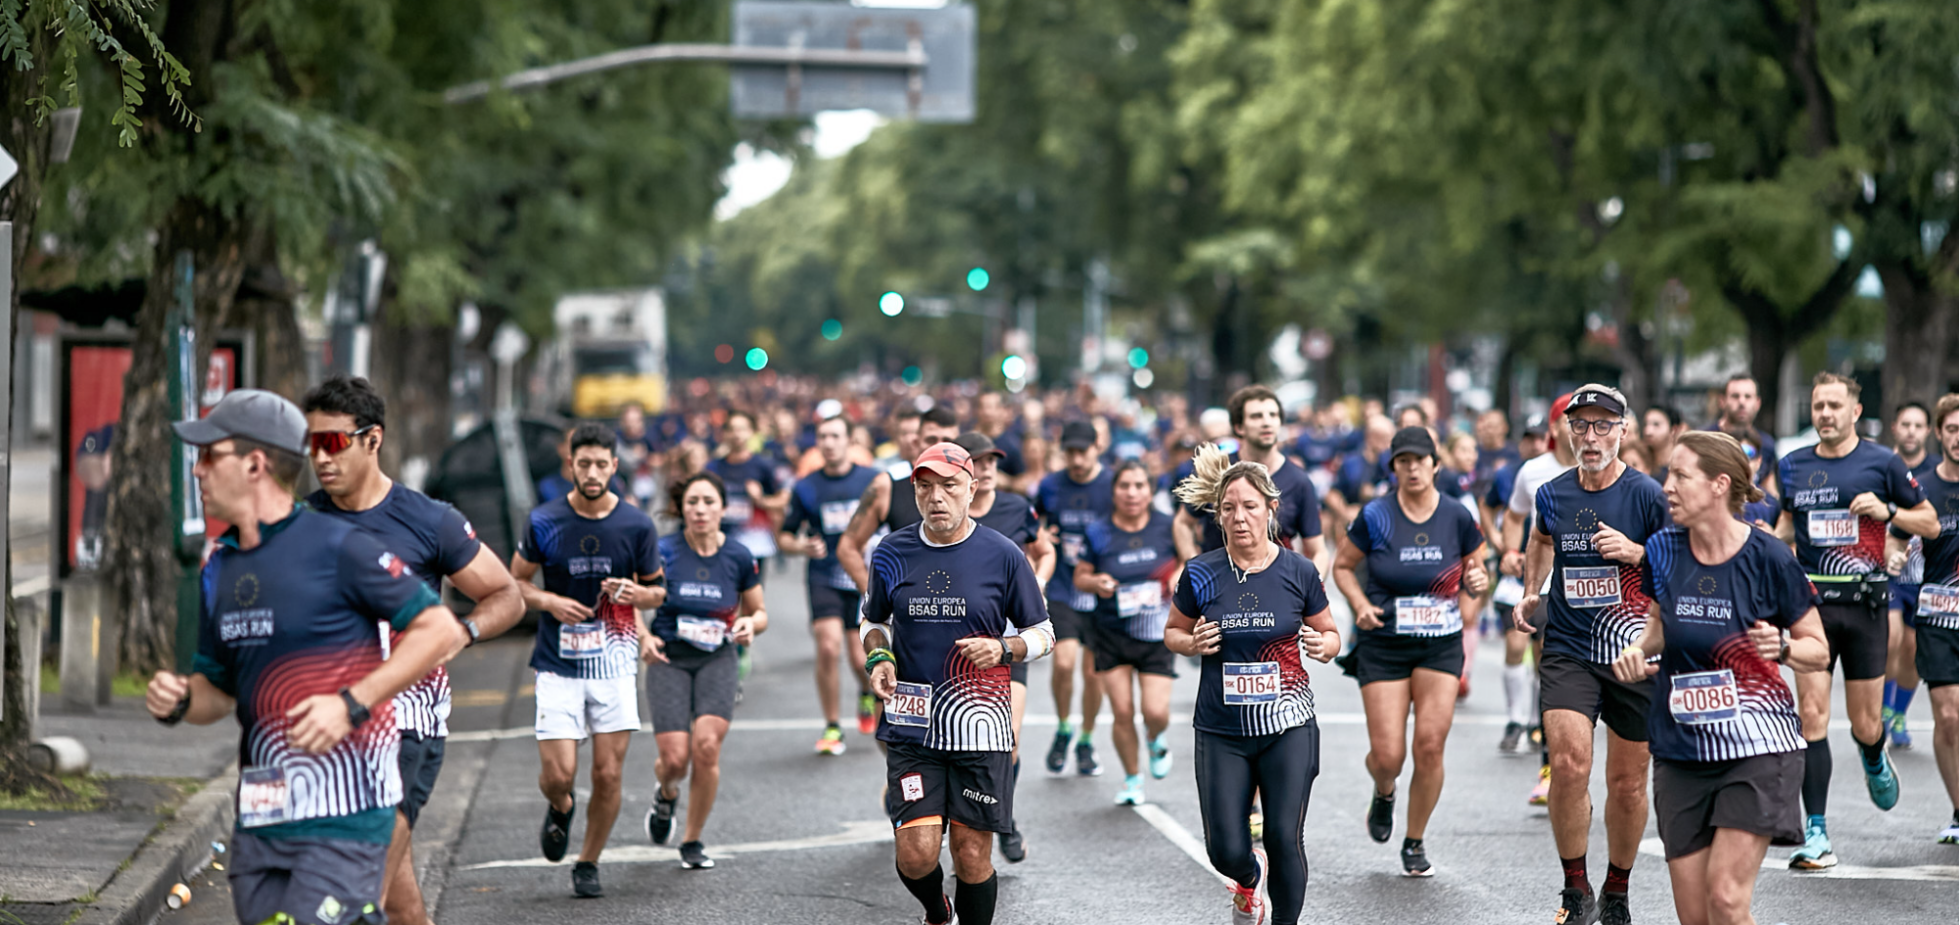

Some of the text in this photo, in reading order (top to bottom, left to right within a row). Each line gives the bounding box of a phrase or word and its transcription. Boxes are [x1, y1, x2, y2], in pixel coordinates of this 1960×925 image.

[1820, 491, 1838, 503] RUN
[1825, 519, 1853, 537] 1168
[1561, 541, 1587, 551] BSAS
[1576, 578, 1618, 597] 0050
[909, 597, 966, 605] UNION EUROPEA
[1678, 596, 1732, 607] UNION EUROPEA
[908, 605, 966, 616] BSAS RUN
[1413, 607, 1441, 624] 1182
[1676, 604, 1732, 620] BSAS RUN
[250, 619, 274, 637] RUN
[1221, 618, 1275, 629] BSAS RUN
[1237, 676, 1276, 693] 0164
[894, 694, 926, 716] 1248
[1683, 686, 1735, 711] 0086
[963, 788, 990, 804] mitre
